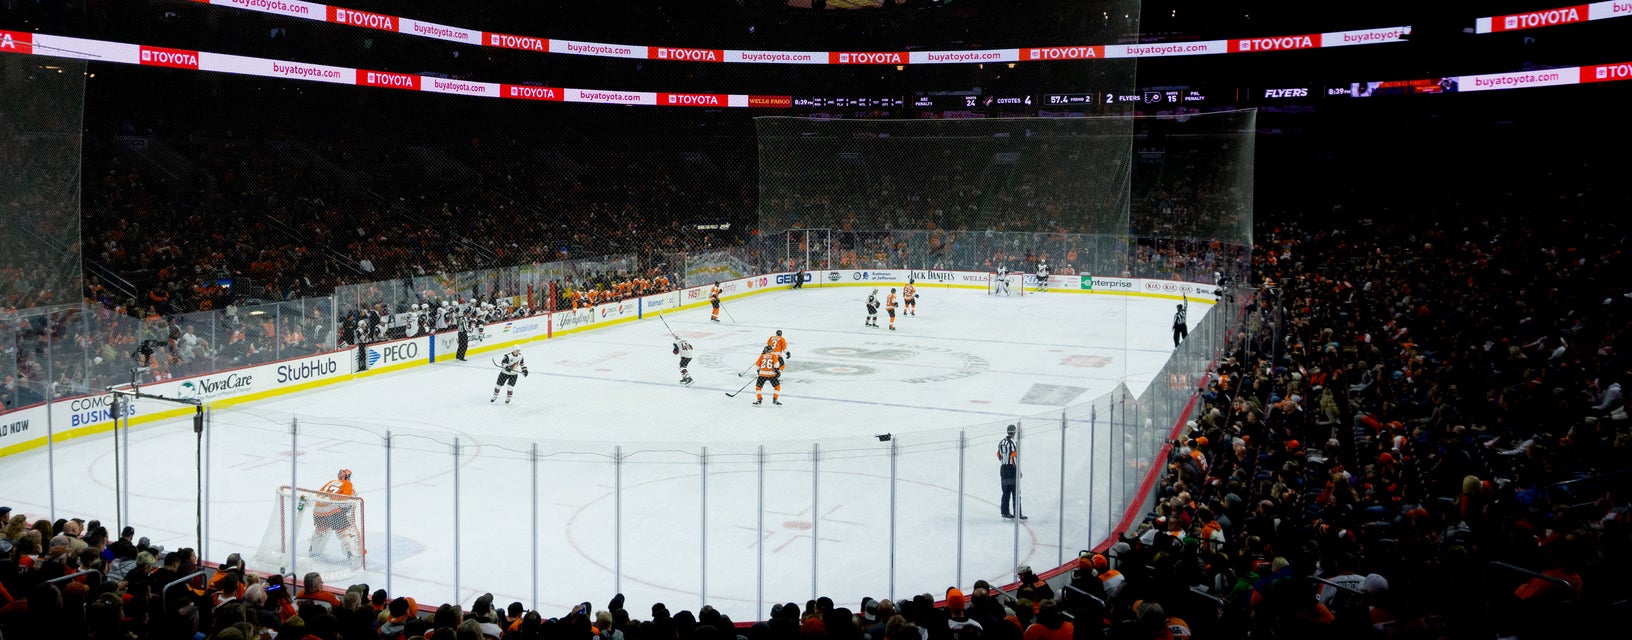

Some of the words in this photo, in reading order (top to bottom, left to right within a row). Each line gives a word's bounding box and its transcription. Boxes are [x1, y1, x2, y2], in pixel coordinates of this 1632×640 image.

[347, 10, 392, 30] TOYOTA
[1519, 8, 1579, 27] TOYOTA
[413, 22, 469, 40] buyatoyota.com
[500, 36, 543, 51] TOYOTA
[567, 43, 631, 56] buyatoyota.com
[1127, 44, 1207, 56] buyatoyota.com
[1252, 37, 1312, 50] TOYOTA
[152, 51, 197, 66] TOYOTA
[669, 48, 716, 61] TOYOTA
[742, 51, 811, 63] buyatoyota.com
[851, 53, 901, 64] TOYOTA
[928, 51, 1001, 62] buyatoyota.com
[1042, 47, 1095, 60] TOYOTA
[273, 62, 341, 80] buyatoyota.com
[375, 73, 413, 87] TOYOTA
[1475, 72, 1559, 87] buyatoyota.com
[434, 79, 486, 94] buyatoyota.com
[518, 87, 555, 99] TOYOTA
[1265, 88, 1308, 98] FLYERS
[580, 91, 641, 103] buyatoyota.com
[677, 94, 718, 106] TOYOTA
[749, 98, 769, 107] WELLS
[1024, 96, 1032, 105] 4
[1106, 94, 1113, 103] 2
[1084, 278, 1132, 289] enterprise
[772, 340, 777, 349] 3
[383, 341, 418, 364] PECO
[277, 357, 337, 384] StubHub
[761, 359, 773, 369] 26
[197, 373, 252, 395] NovaCare
[10, 419, 29, 434] NOW
